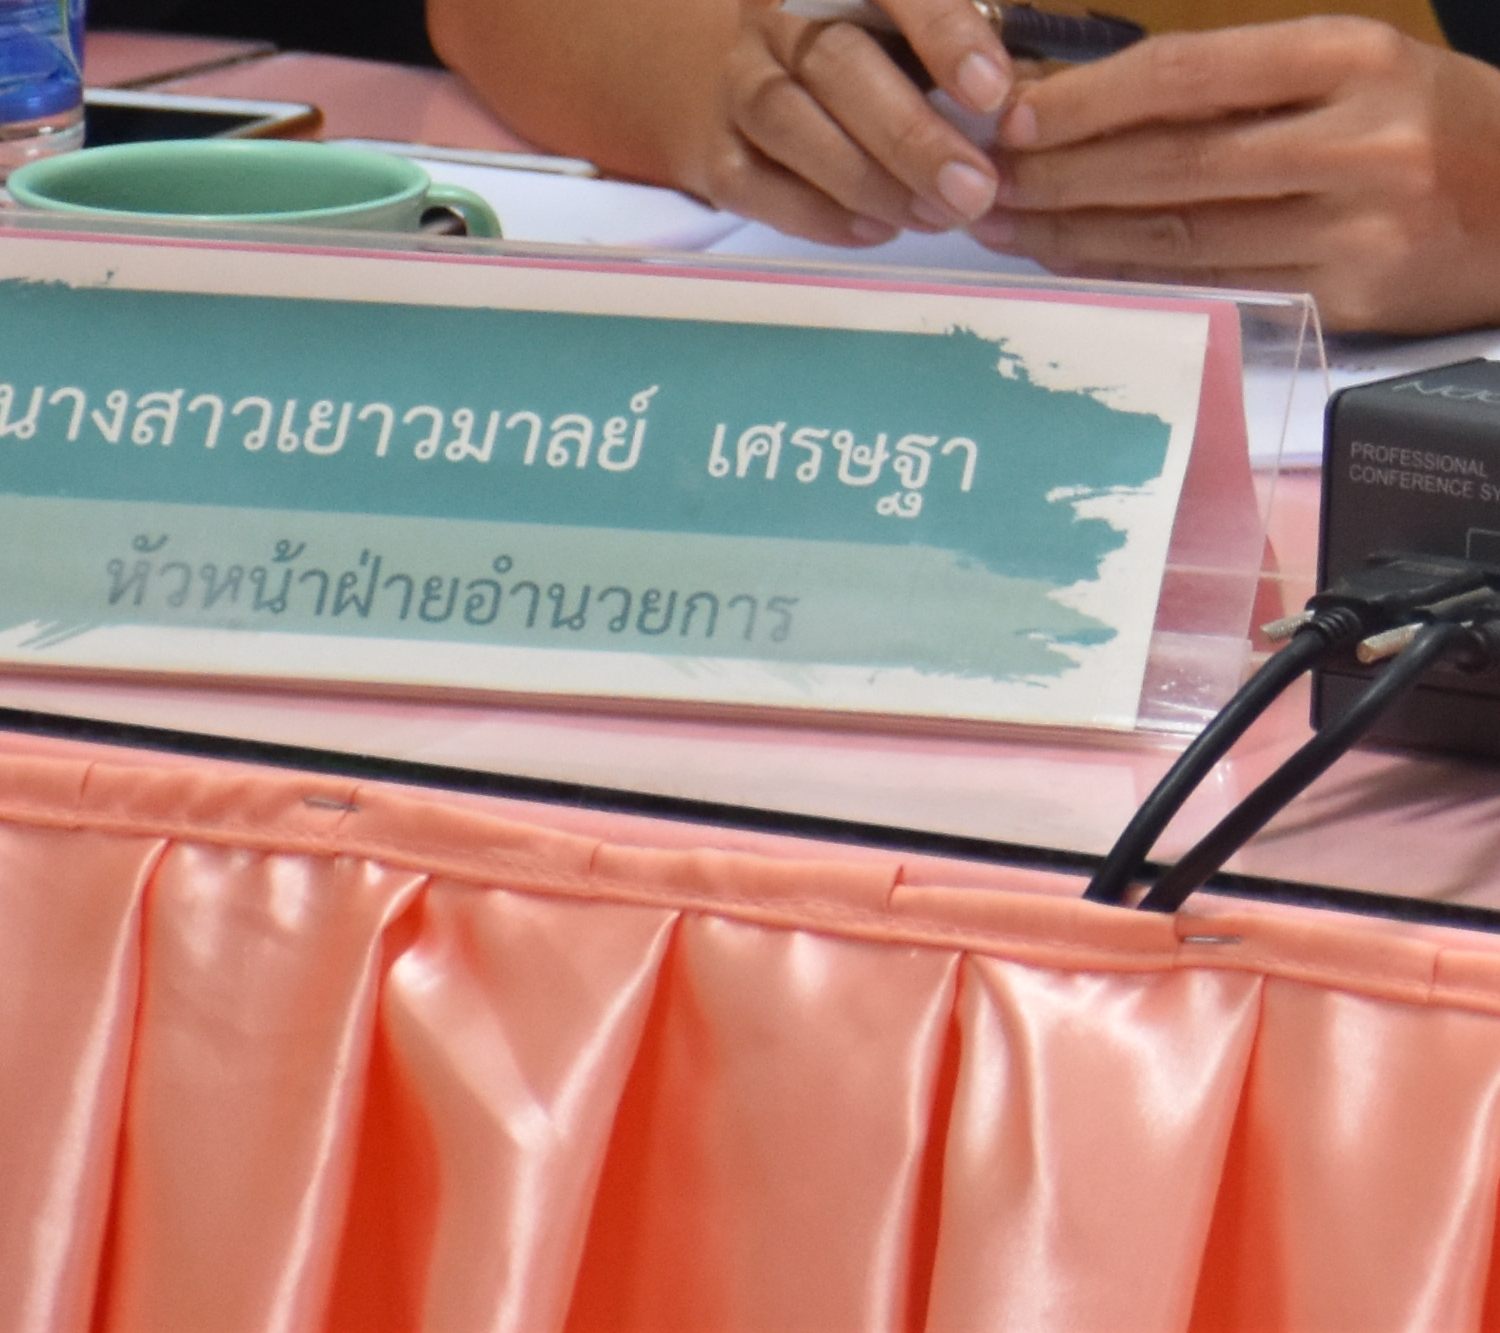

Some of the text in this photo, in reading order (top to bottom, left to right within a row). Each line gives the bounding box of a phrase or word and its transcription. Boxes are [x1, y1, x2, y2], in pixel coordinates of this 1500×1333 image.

[0, 383, 978, 518] นางสาวเยาวมาลย์ เศรษฐา
[1349, 464, 1474, 499] CONFERENCE
[1351, 441, 1489, 478] PROFESSIONAL
[105, 533, 800, 643] หัวหน้าฝ่ายอำนวยการ
